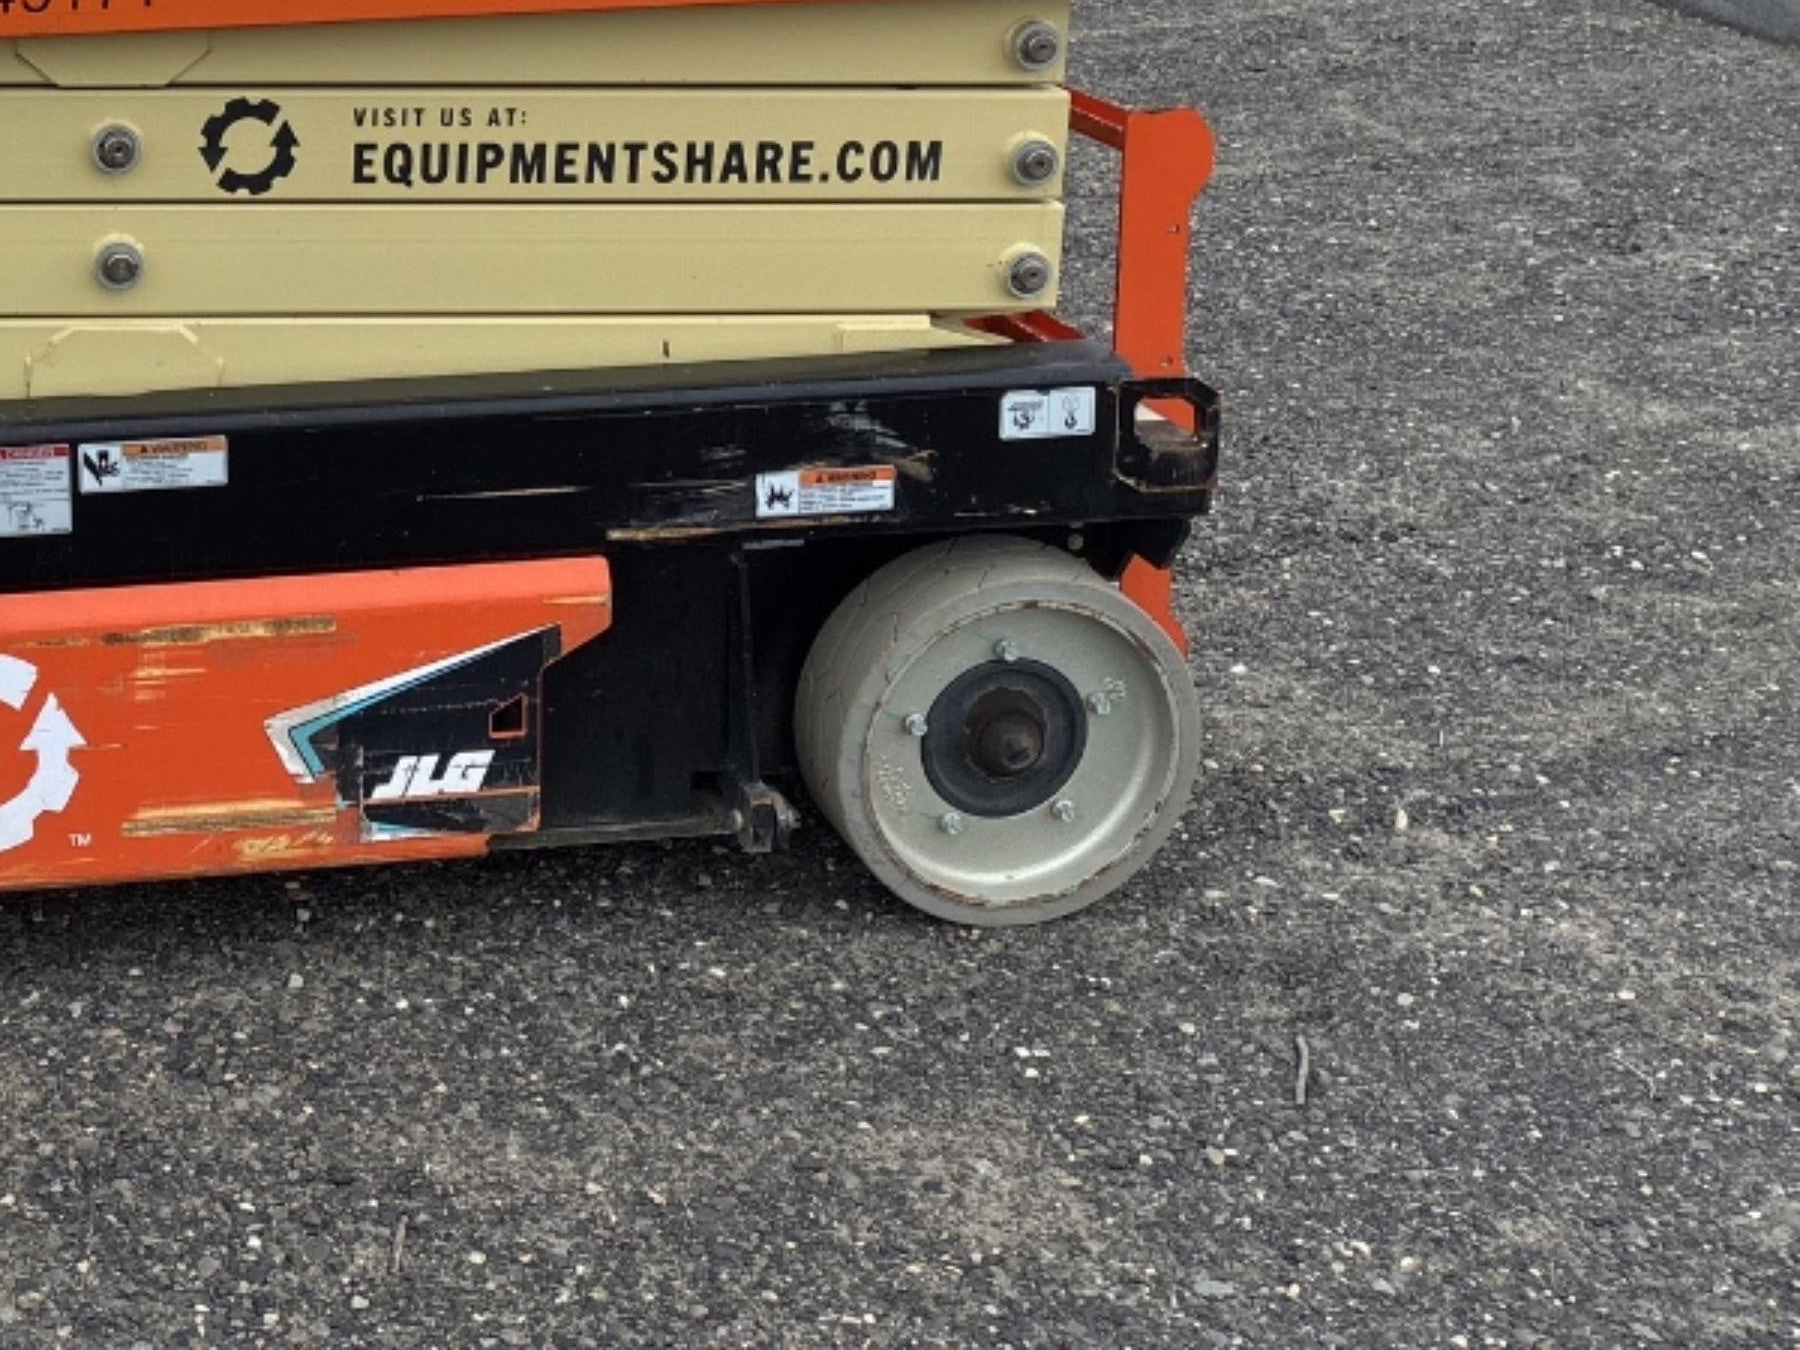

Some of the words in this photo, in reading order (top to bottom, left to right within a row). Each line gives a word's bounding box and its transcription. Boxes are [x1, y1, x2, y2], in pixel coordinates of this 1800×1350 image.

[352, 107, 425, 128] VISIT
[440, 107, 473, 128] US
[488, 107, 528, 128] AT:
[352, 140, 943, 189] EQUIPMENTSHARE.COM
[371, 748, 497, 800] JLG
